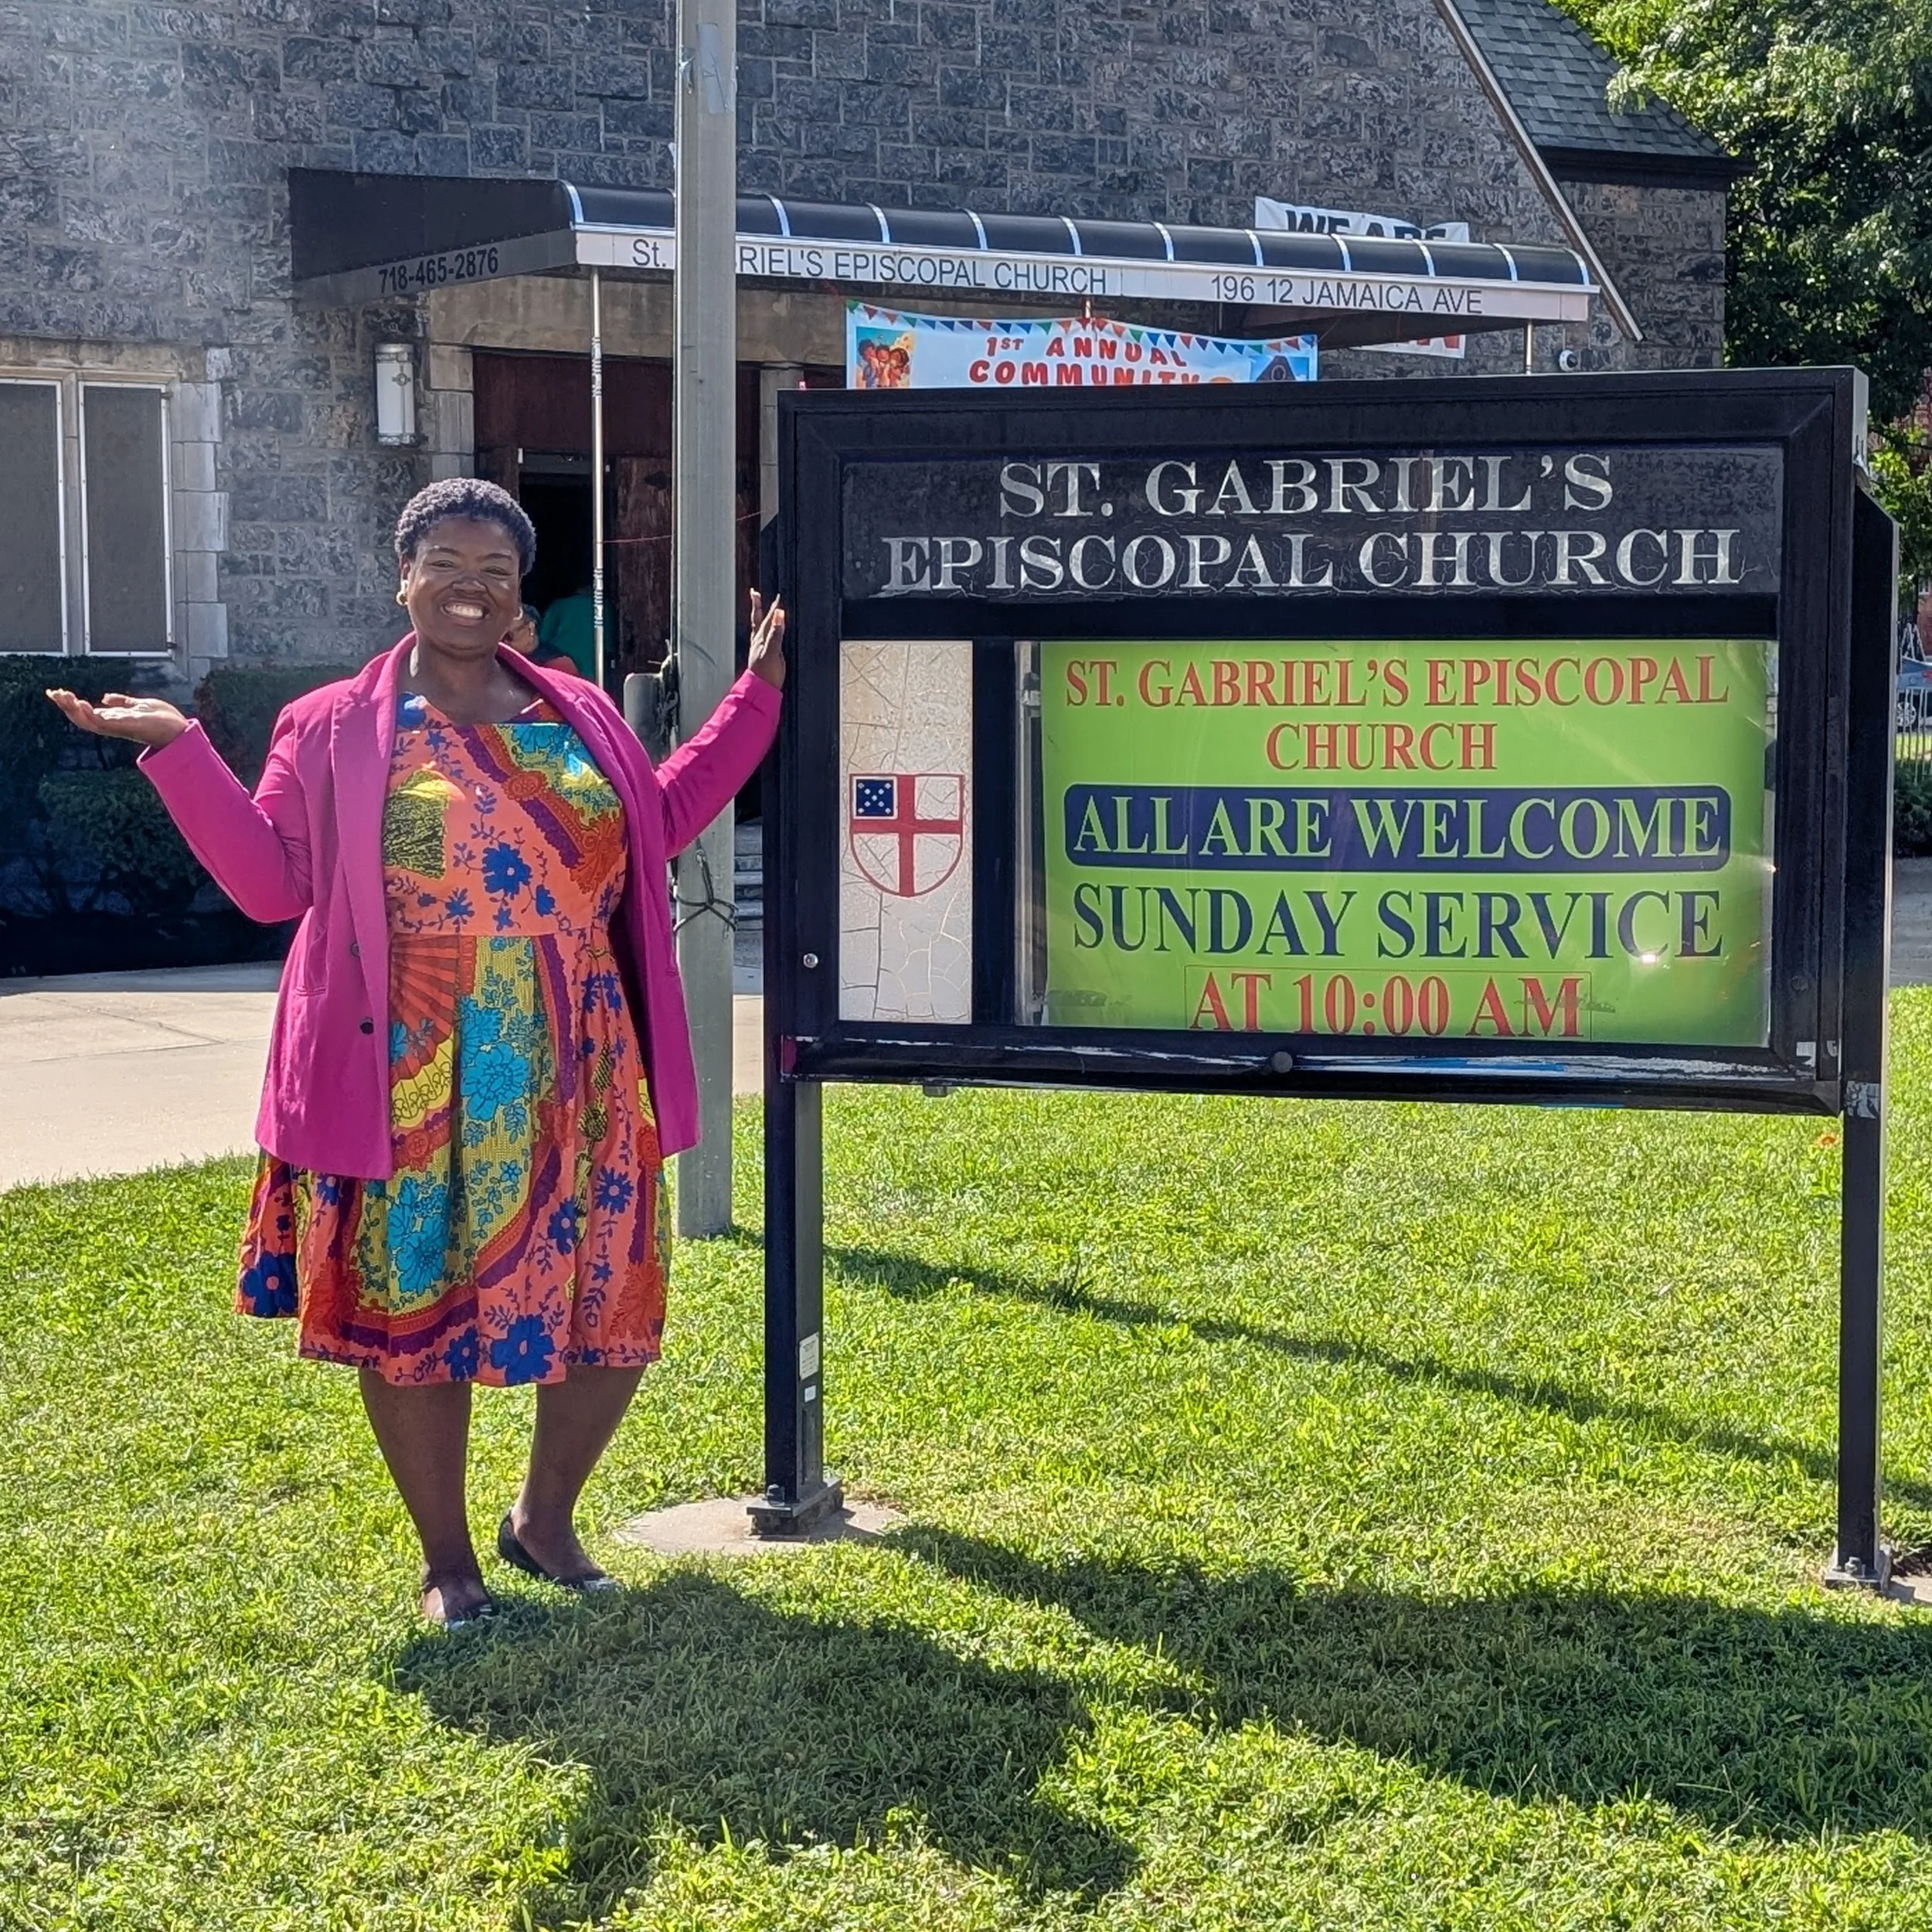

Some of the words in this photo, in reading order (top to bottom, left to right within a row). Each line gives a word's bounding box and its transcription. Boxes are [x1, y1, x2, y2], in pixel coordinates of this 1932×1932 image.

[379, 247, 498, 294] 718-465-2876
[632, 238, 666, 267] St.
[736, 246, 822, 277] RIEL'S
[835, 252, 985, 287] EPISCOPAL
[995, 261, 1106, 294] CHURCH
[1211, 275, 1255, 302] 196
[1267, 278, 1293, 304] 12
[1302, 281, 1423, 311] JAMAICA
[1433, 288, 1483, 314] AVE
[986, 336, 1024, 357] 1ST
[1046, 336, 1187, 367] ANNUAL
[998, 461, 1111, 518] ST.
[1146, 454, 1614, 517] GABRIEL’S
[883, 534, 1338, 592] EPISCOPAL
[1359, 528, 1742, 587] CHURCH
[1066, 659, 1124, 707] ST.
[1138, 658, 1409, 708] GABRIEL’S
[1425, 656, 1730, 706] EPISCOPAL
[1266, 722, 1498, 771] CHURCH
[1073, 795, 1189, 856] ALL
[1197, 796, 1333, 858] ARE
[1349, 796, 1722, 860] WELCOME
[1073, 883, 1358, 958] SUNDAY
[1377, 889, 1723, 961] SERVICE
[1189, 971, 1273, 1032] AT
[1292, 974, 1450, 1037] 10:00
[1465, 976, 1584, 1037] AM
